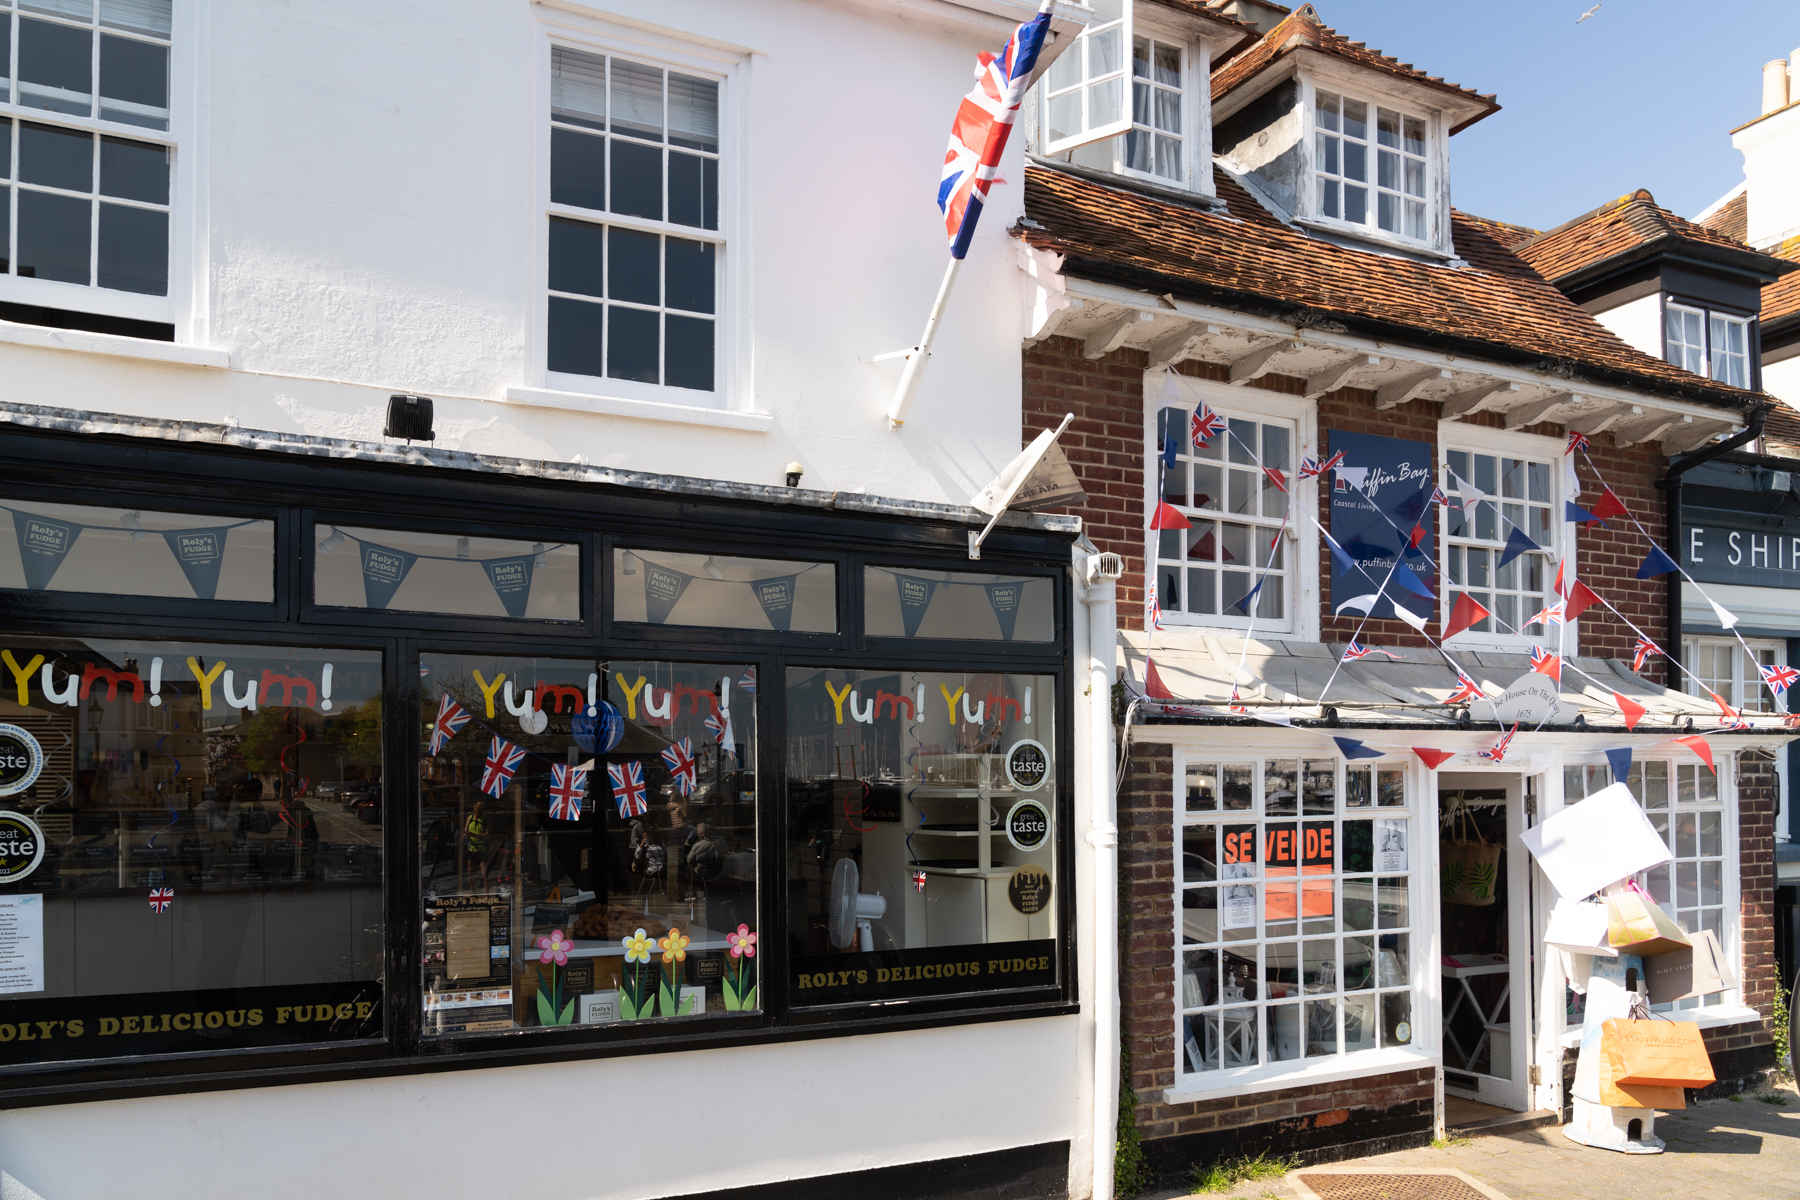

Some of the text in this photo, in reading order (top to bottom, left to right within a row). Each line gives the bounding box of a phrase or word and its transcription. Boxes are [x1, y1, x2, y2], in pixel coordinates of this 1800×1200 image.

[1352, 462, 1430, 497] uffin Bay
[1016, 483, 1060, 500] CREAM
[1333, 499, 1376, 513] Coastal Living
[31, 524, 64, 537] Roly's
[30, 533, 62, 545] FUDGE
[182, 537, 213, 546] Roly's
[370, 552, 399, 566] Roly's
[369, 561, 397, 573] FUDGE
[495, 565, 521, 574] Roly's
[653, 572, 677, 585] Roly's
[652, 580, 675, 591] FUDGE
[762, 585, 785, 594] Roly's
[905, 582, 924, 591] Roly's
[1, 649, 163, 707] Yum!
[186, 655, 333, 711] Yum!
[472, 669, 731, 720] Yum! Yum!
[1505, 690, 1527, 702] House
[1528, 686, 1538, 695] On
[1539, 689, 1550, 701] The
[825, 680, 1032, 725] Yum! Yum!
[1516, 709, 1532, 717] 1675
[1012, 761, 1044, 772] taste
[1012, 821, 1045, 832] taste
[1225, 828, 1332, 864] SE VENDE
[436, 897, 499, 906] Roly's Fudge
[567, 969, 587, 977] Roly's
[798, 956, 1050, 989] ROLY'S DELICIOUS FUDGE
[1656, 967, 1673, 975] MINT
[98, 1007, 264, 1037] DELICIOUS
[275, 1001, 373, 1024] FUDGE
[1624, 1035, 1699, 1046] STANWELLS.COM
